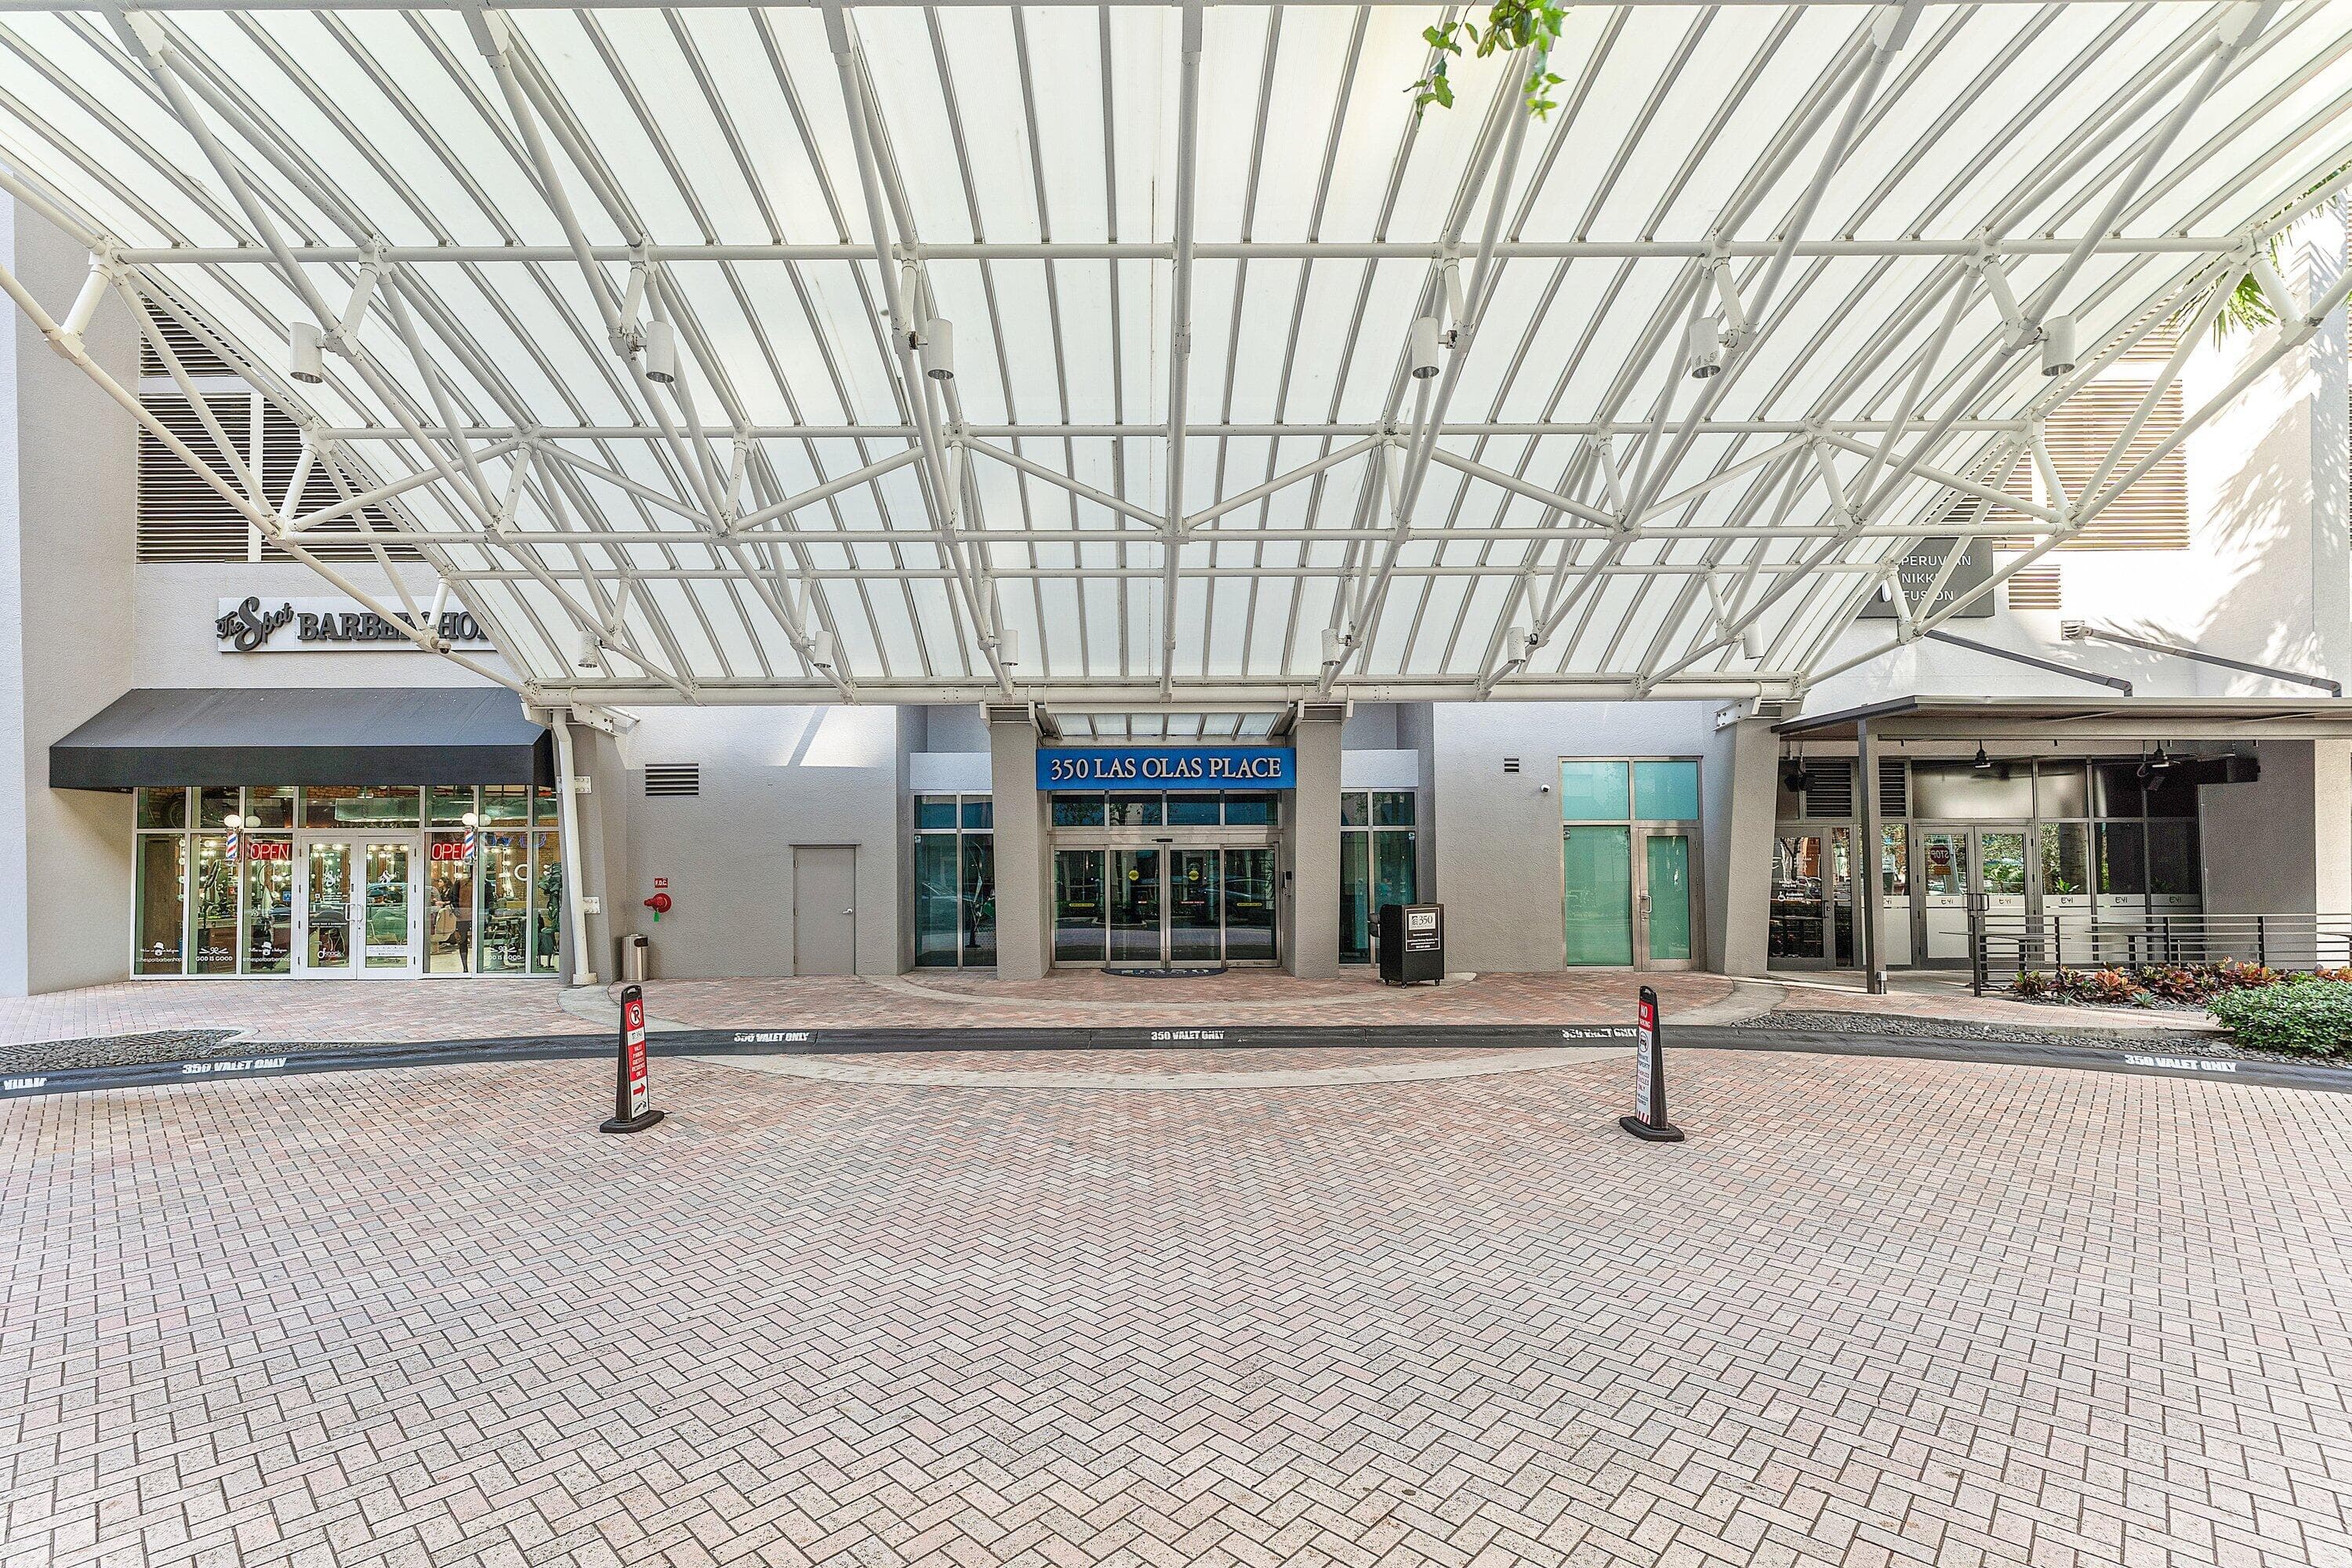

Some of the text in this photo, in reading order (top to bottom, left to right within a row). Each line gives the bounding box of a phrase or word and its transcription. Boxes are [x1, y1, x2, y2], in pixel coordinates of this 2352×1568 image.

[1902, 555, 1971, 566] PERUVN
[1902, 573, 1939, 583] NIKK
[1903, 590, 1954, 601] FUSON
[216, 596, 489, 652] The Spot BARBEHO
[1051, 757, 1282, 780] 350 LAS OLAS PLACE
[250, 843, 289, 860] OPEN
[1419, 916, 1433, 925] 350
[1640, 1004, 1648, 1018] NO
[756, 1033, 786, 1043] VALET
[785, 1032, 810, 1042] ONLY
[1151, 1031, 1171, 1040] 350
[1172, 1030, 1201, 1040] VALET
[182, 1057, 287, 1074] 350 VALET ONLY
[2124, 1054, 2237, 1072] 350 VALET ONLY
